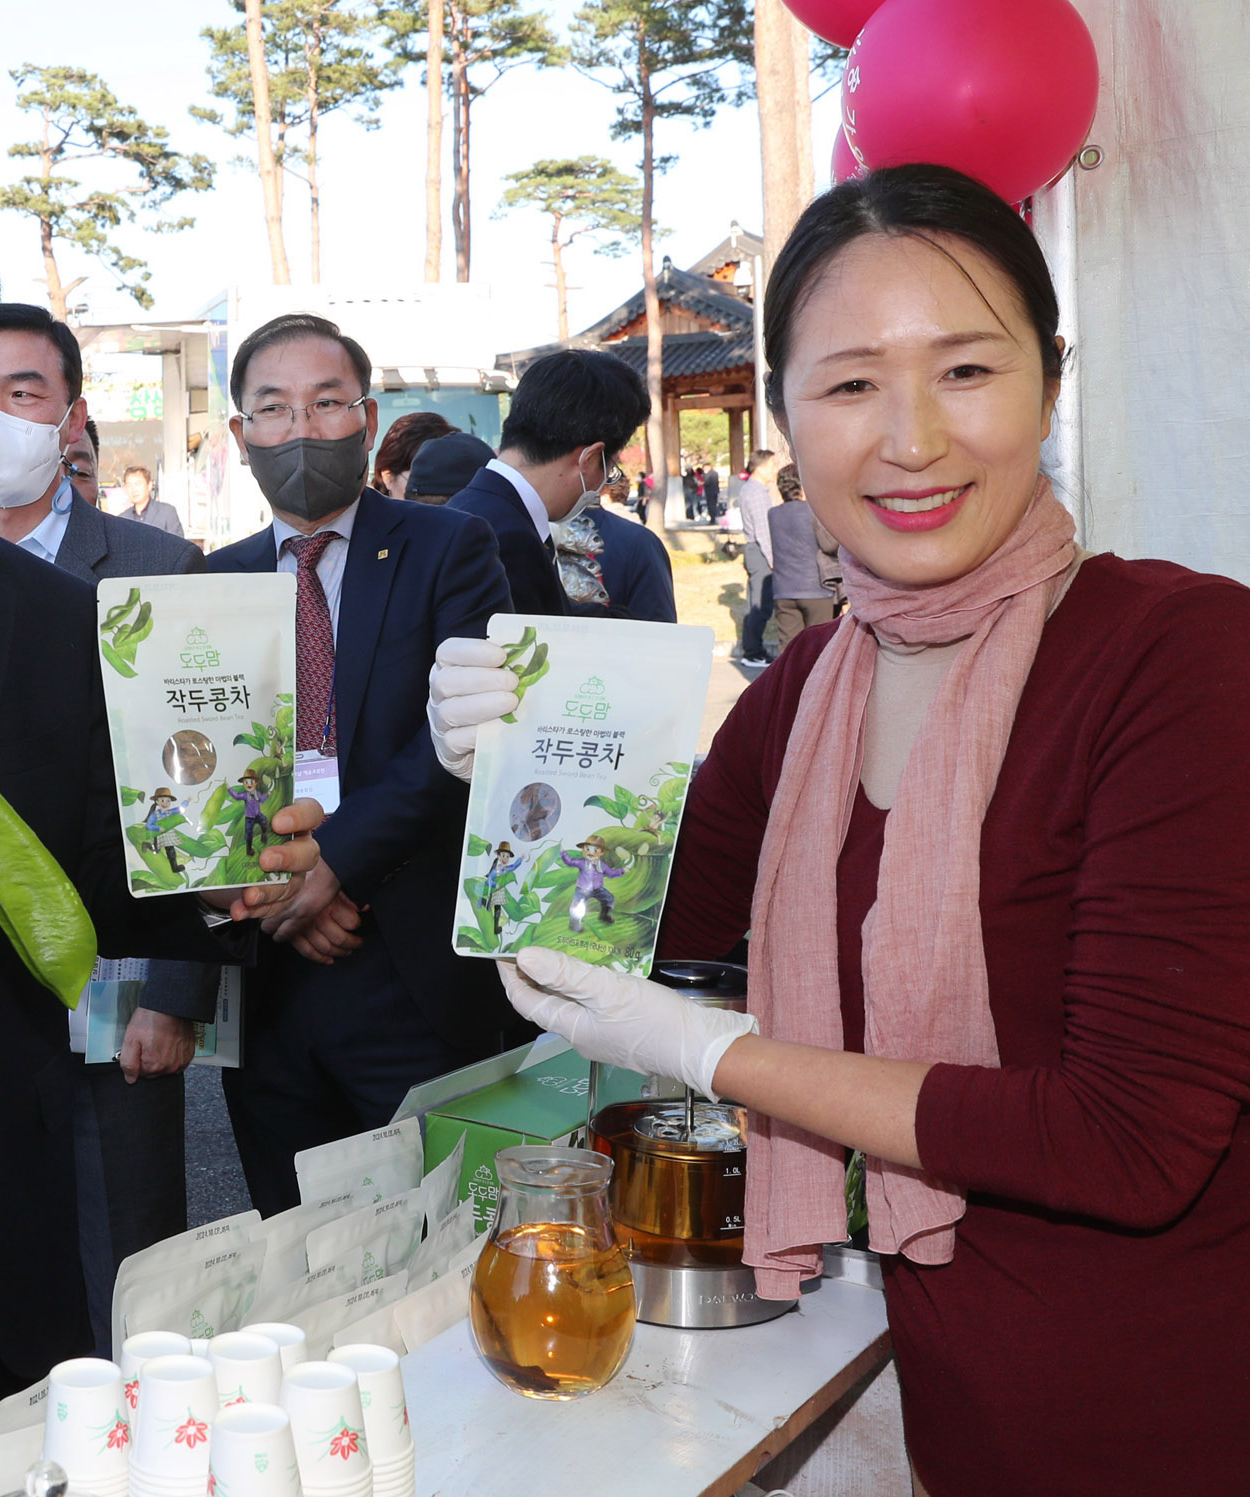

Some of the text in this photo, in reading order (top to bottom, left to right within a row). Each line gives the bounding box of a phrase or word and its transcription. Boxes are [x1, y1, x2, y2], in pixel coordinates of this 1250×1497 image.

[180, 650, 220, 672] 도두맘
[166, 685, 251, 713] 작두콩차
[561, 700, 611, 723] 도두맘
[531, 738, 625, 771] 작두콩차
[725, 1166, 741, 1174] 1.0L
[725, 1215, 741, 1223] 0.5L
